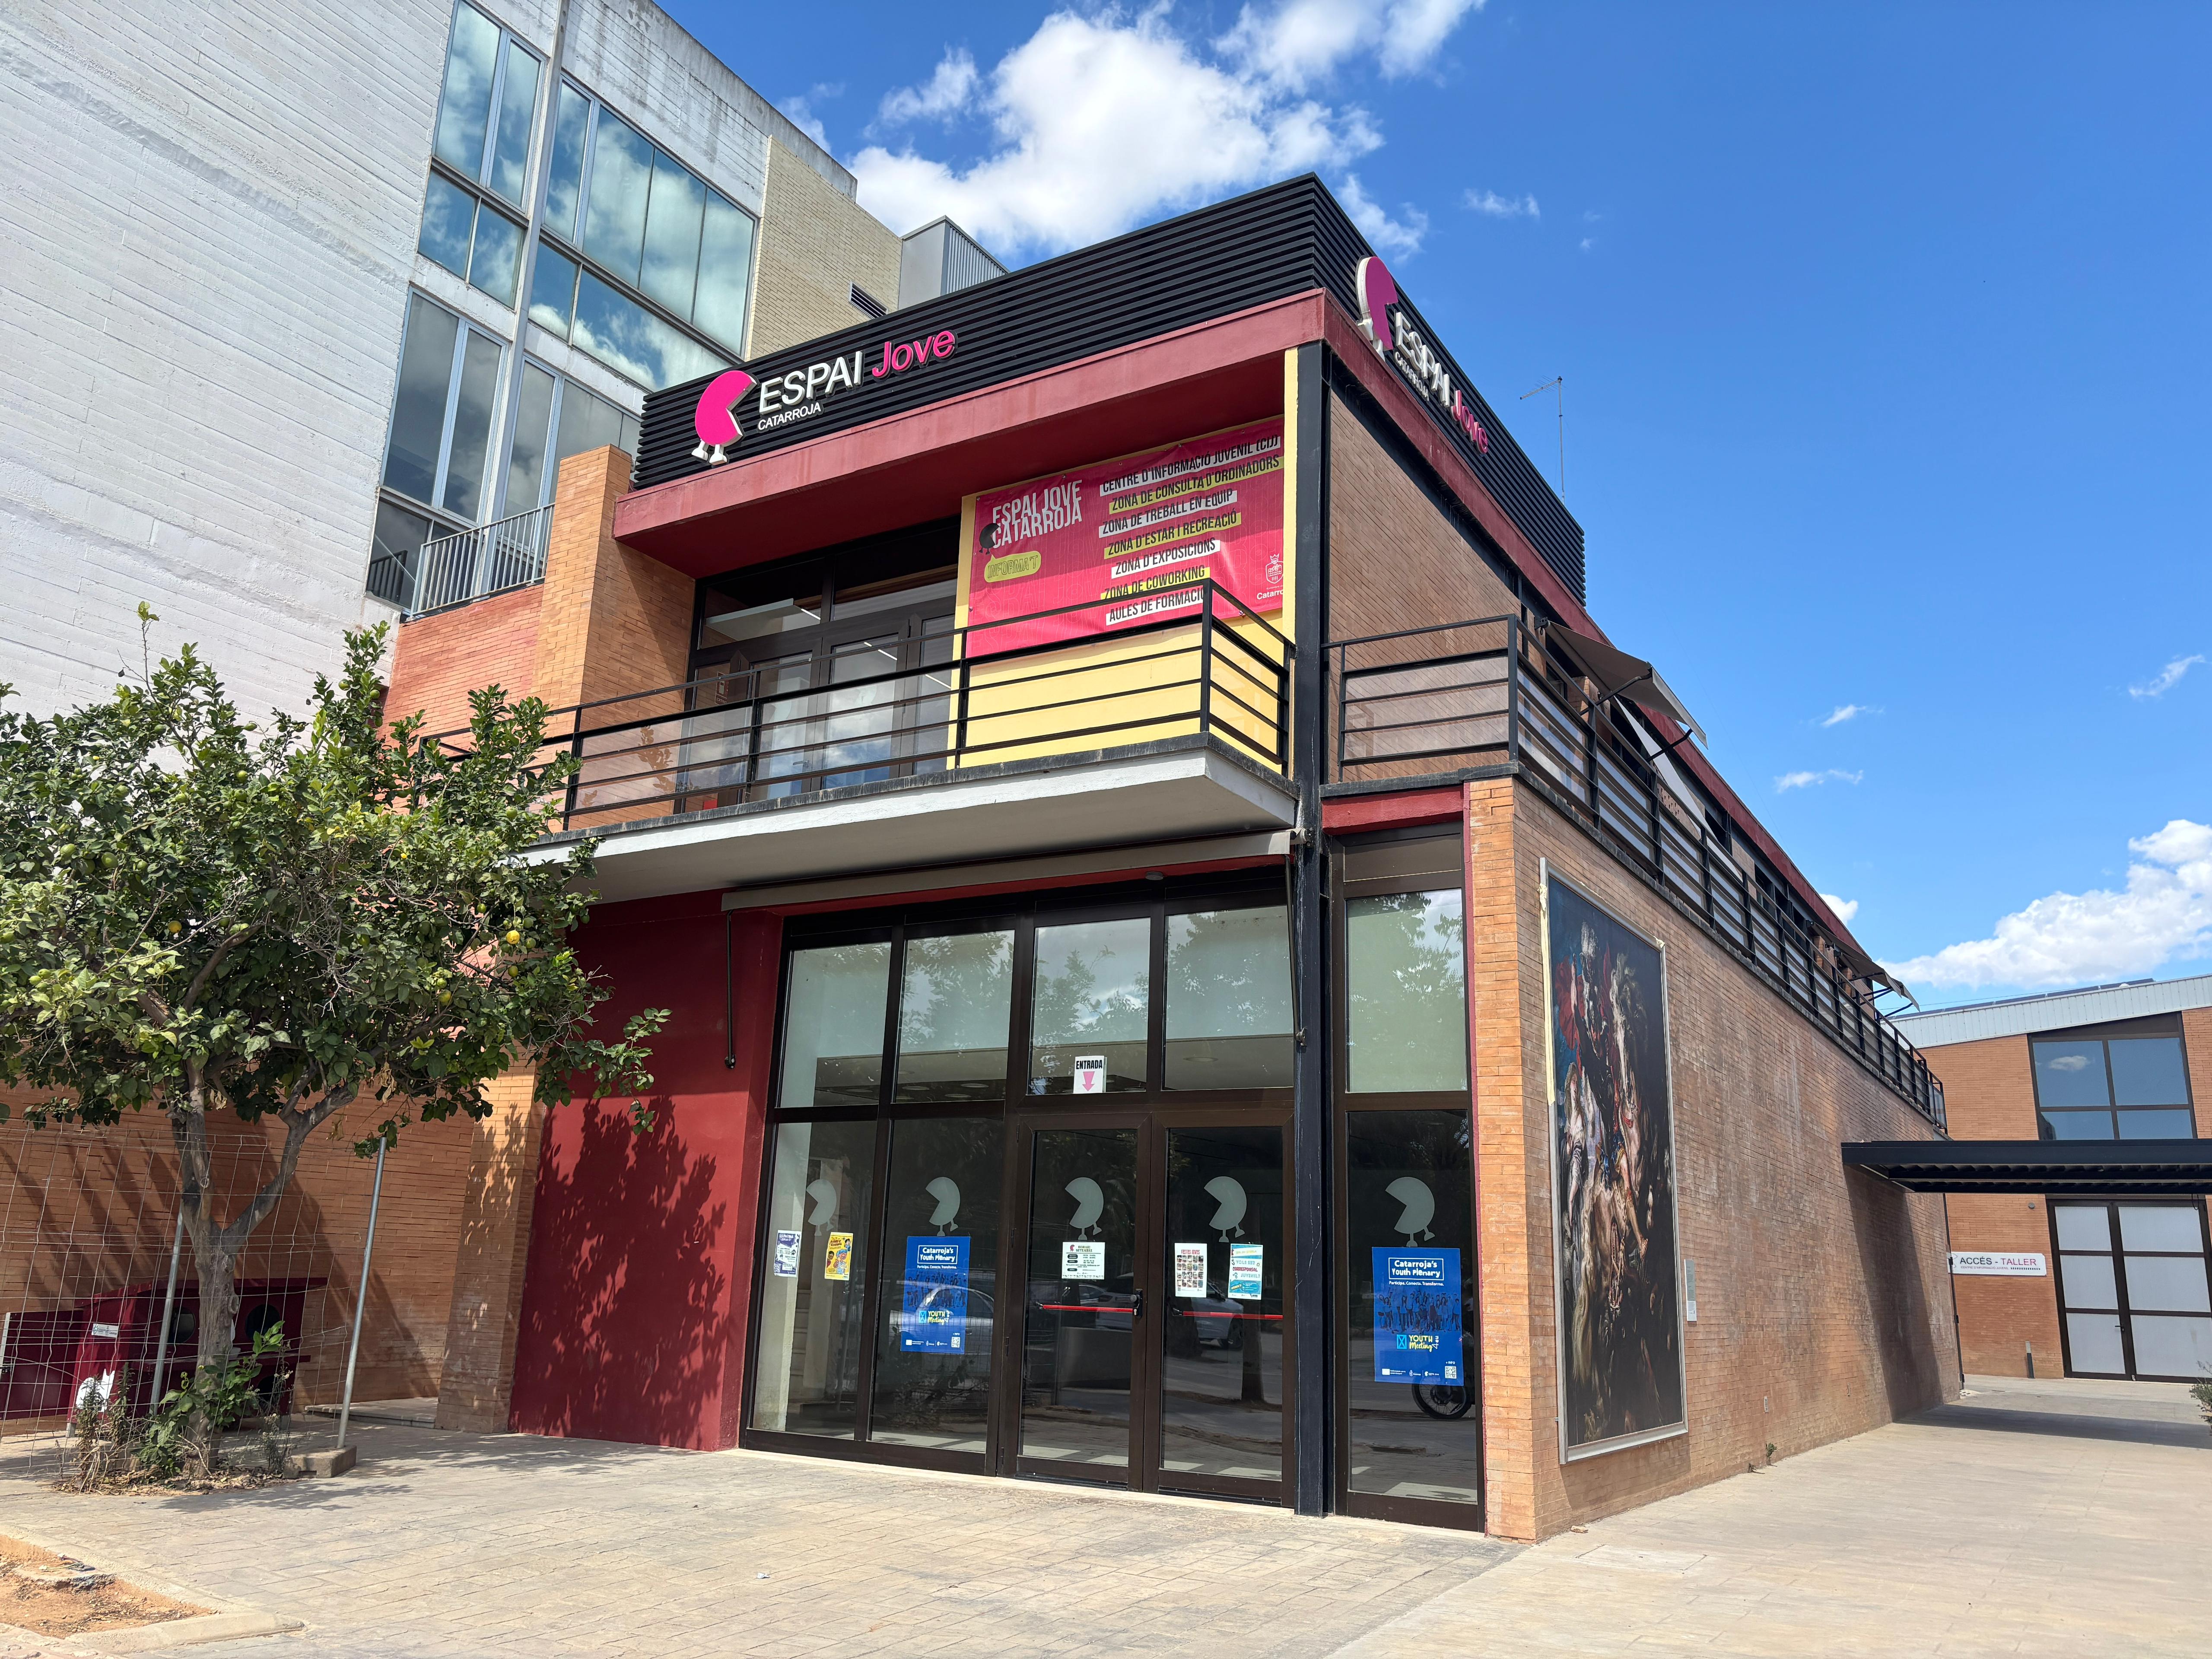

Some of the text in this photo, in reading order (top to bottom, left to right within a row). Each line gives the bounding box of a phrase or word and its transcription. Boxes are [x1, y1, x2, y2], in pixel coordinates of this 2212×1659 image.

[759, 331, 956, 415] ESPAI Jove
[1395, 351, 1430, 401] CATARROJA
[1396, 311, 1489, 454] ESPAI Jove
[758, 402, 822, 431] CATARROJA
[1103, 471, 1139, 493] CENTRE
[1142, 451, 1211, 482] D'INFORMACIÓ
[1214, 442, 1253, 464] JUVENIL
[1112, 454, 1279, 511] ZONA DE CONSULTA D'ORDINADORS
[993, 480, 1082, 525] ESPAI JOVE
[1103, 488, 1233, 534] ZONA DE TREBALL EN EQUIP
[992, 496, 1082, 548] CATARROJA
[1108, 509, 1236, 556] ZONA D'ESTAR I RECREACIÓ
[988, 556, 1038, 578] INFORMA'T
[1116, 557, 1141, 575] ZONA
[1144, 537, 1215, 568] D'EXPOSICIONS
[1104, 565, 1205, 600] ZONA DE COWORKING
[1109, 603, 1138, 622] AULES
[1141, 598, 1153, 613] DE
[1076, 1060, 1103, 1069] ENTRADA
[922, 1247, 953, 1255] Catarroja's
[1394, 1260, 1437, 1269] Catarroja's
[1960, 1256, 1992, 1265] ACCÉS
[1412, 1268, 1440, 1278] Plenary
[1409, 1341, 1433, 1352] Meeting
